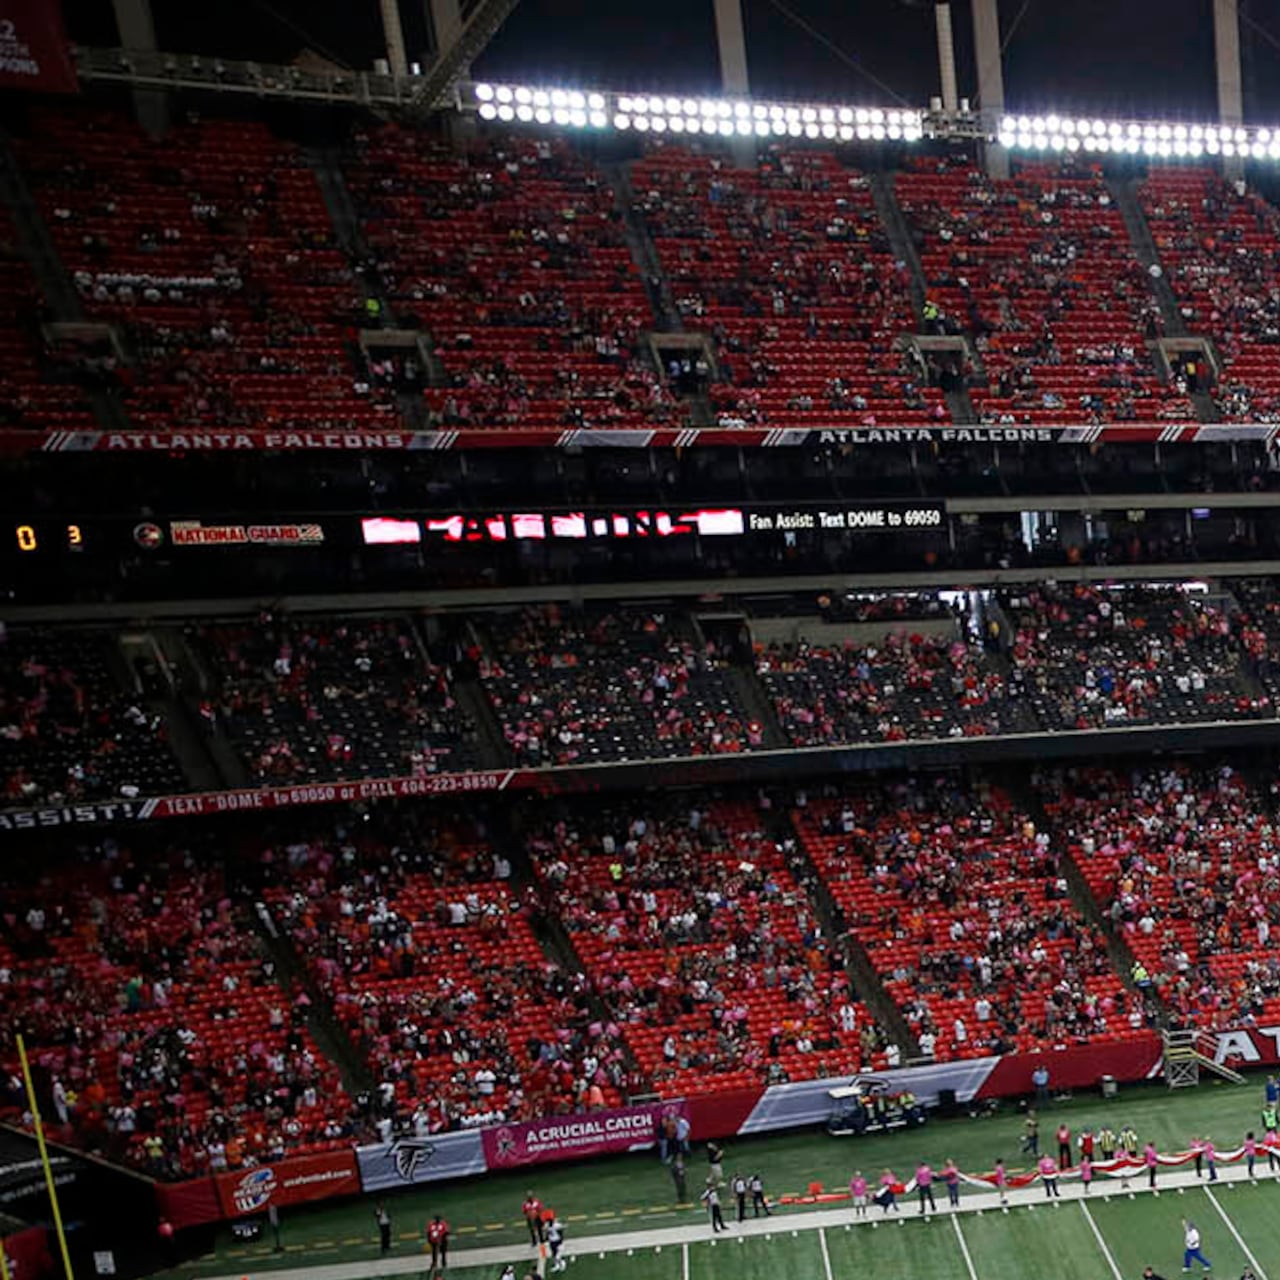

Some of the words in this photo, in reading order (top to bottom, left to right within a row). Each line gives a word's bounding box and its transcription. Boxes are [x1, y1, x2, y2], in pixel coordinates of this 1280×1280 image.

[108, 434, 256, 450] ATLANTA
[265, 433, 404, 449] FALCONS
[819, 428, 933, 444] ATLANTA
[942, 427, 1052, 443] FALCONS
[749, 512, 772, 531] Fan
[776, 511, 814, 530] Assist:
[819, 511, 845, 528] Text
[847, 511, 885, 528] DOME
[888, 512, 900, 527] to
[905, 510, 940, 527] 69050
[16, 525, 38, 552] 0
[67, 524, 83, 545] 3
[173, 525, 248, 545] NATIONAL
[250, 526, 299, 543] GUARD
[0, 803, 133, 831] ASSIST!
[166, 798, 203, 815] TEXT
[290, 788, 334, 802] 69050
[525, 1129, 538, 1144] A
[538, 1120, 604, 1141] CRUCIAL
[605, 1113, 654, 1131] CATCH
